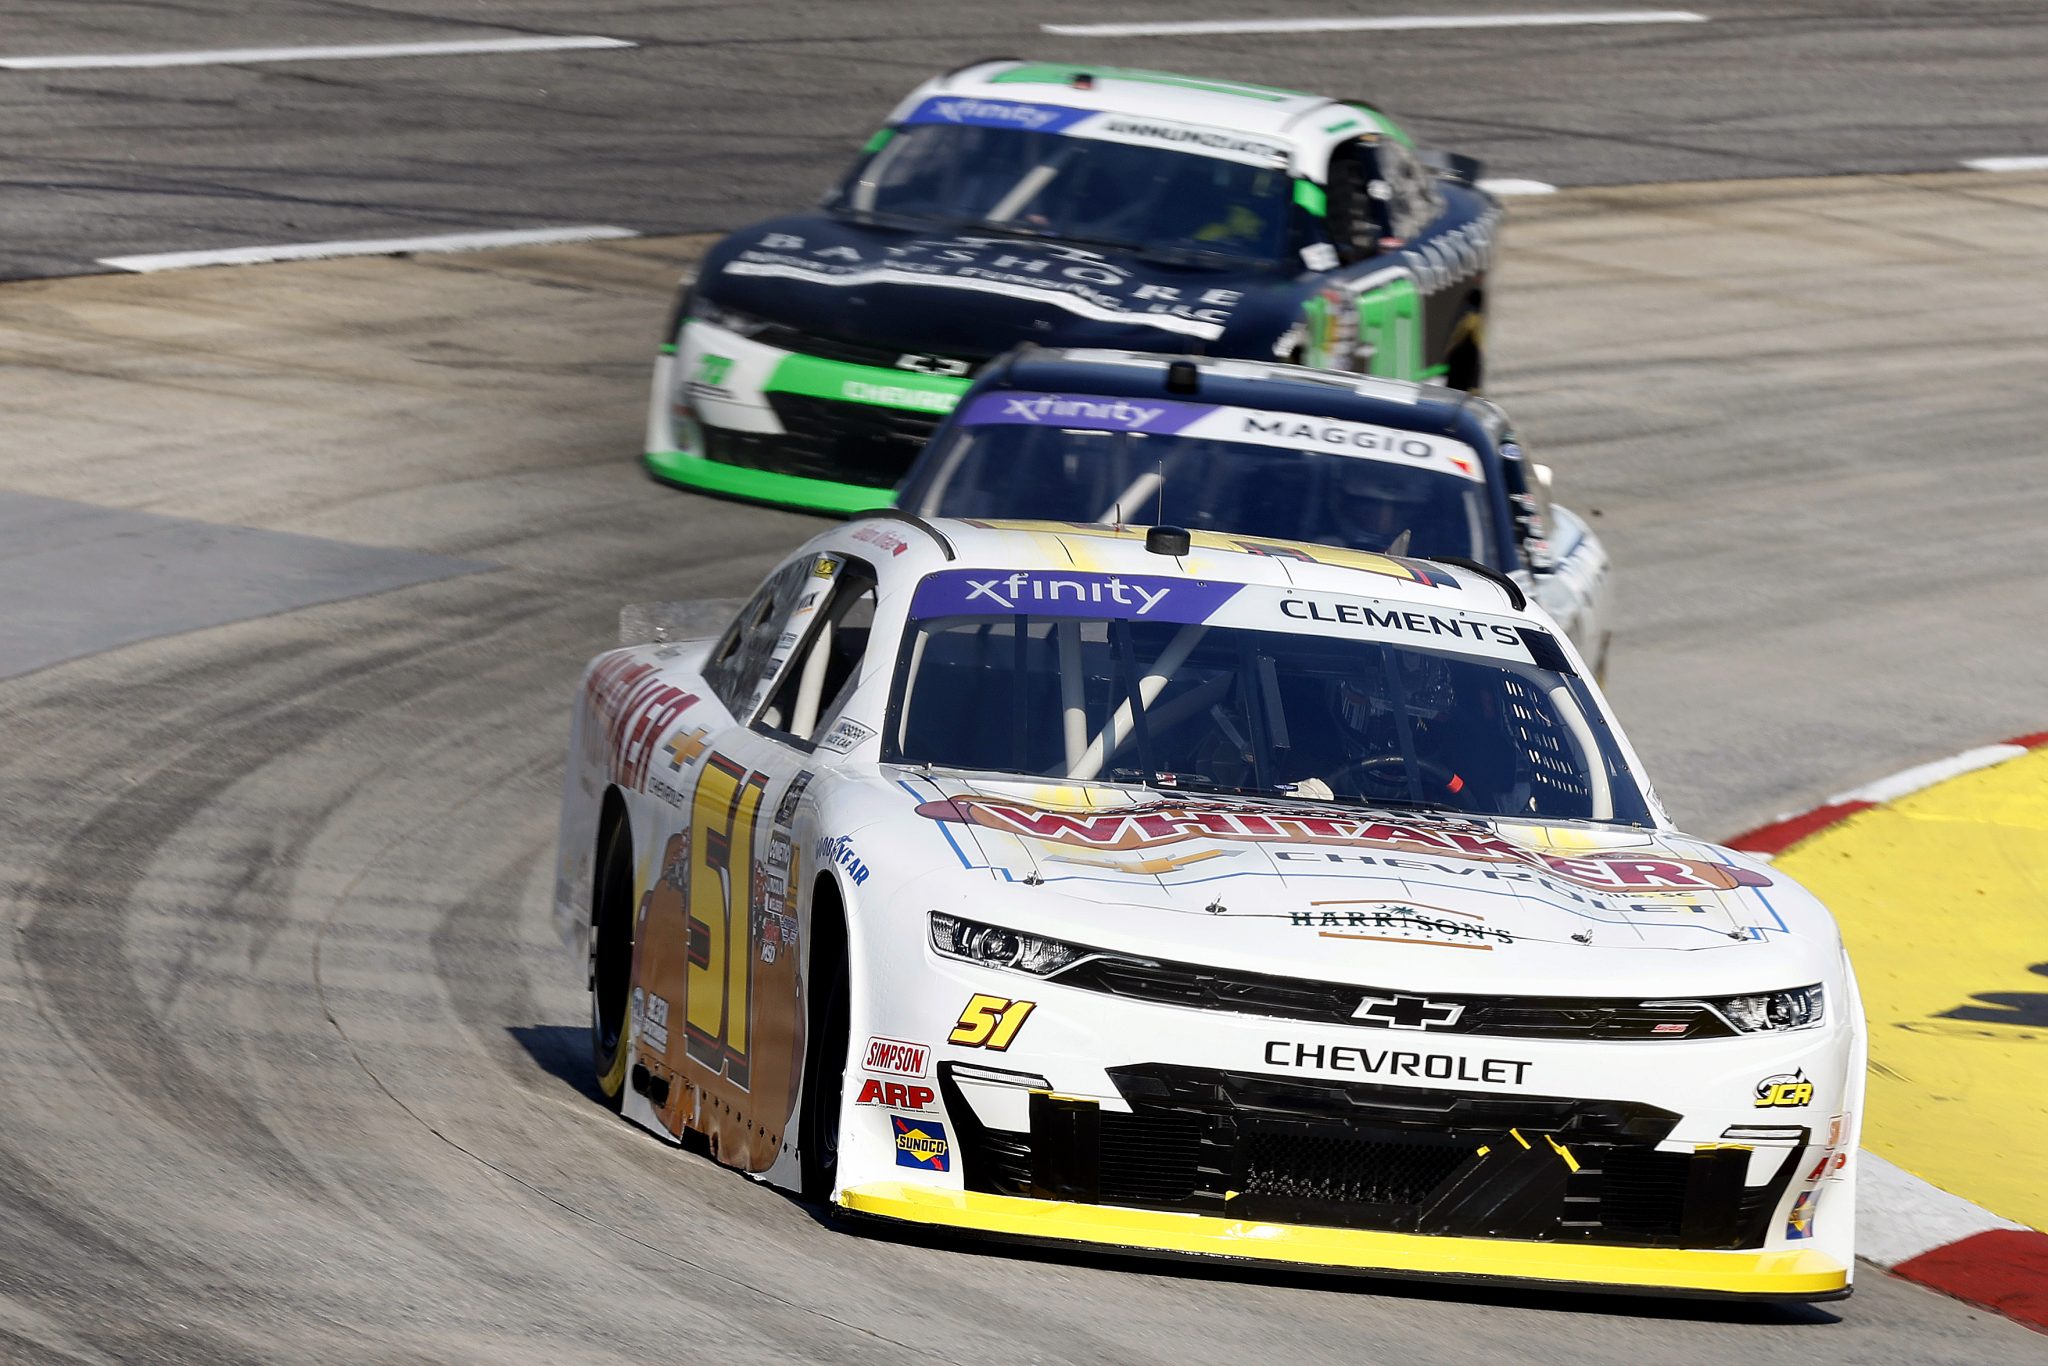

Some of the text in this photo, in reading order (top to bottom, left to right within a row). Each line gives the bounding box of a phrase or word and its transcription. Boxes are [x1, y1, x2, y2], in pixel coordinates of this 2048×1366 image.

[1003, 397, 1166, 431] xfinity
[1243, 415, 1433, 459] MAGGIO
[965, 573, 1171, 615] xfinity
[1280, 599, 1520, 646] CLEMENTS
[968, 801, 1722, 888] WHITAKER
[684, 751, 769, 1087] 51
[947, 992, 1037, 1052] 51
[867, 1042, 924, 1073] SIMPSON
[1264, 1040, 1533, 1085] CHEVROLET
[856, 1079, 935, 1109] ARP
[1754, 1082, 1813, 1107] JCR
[899, 1136, 944, 1153] SUNOCO
